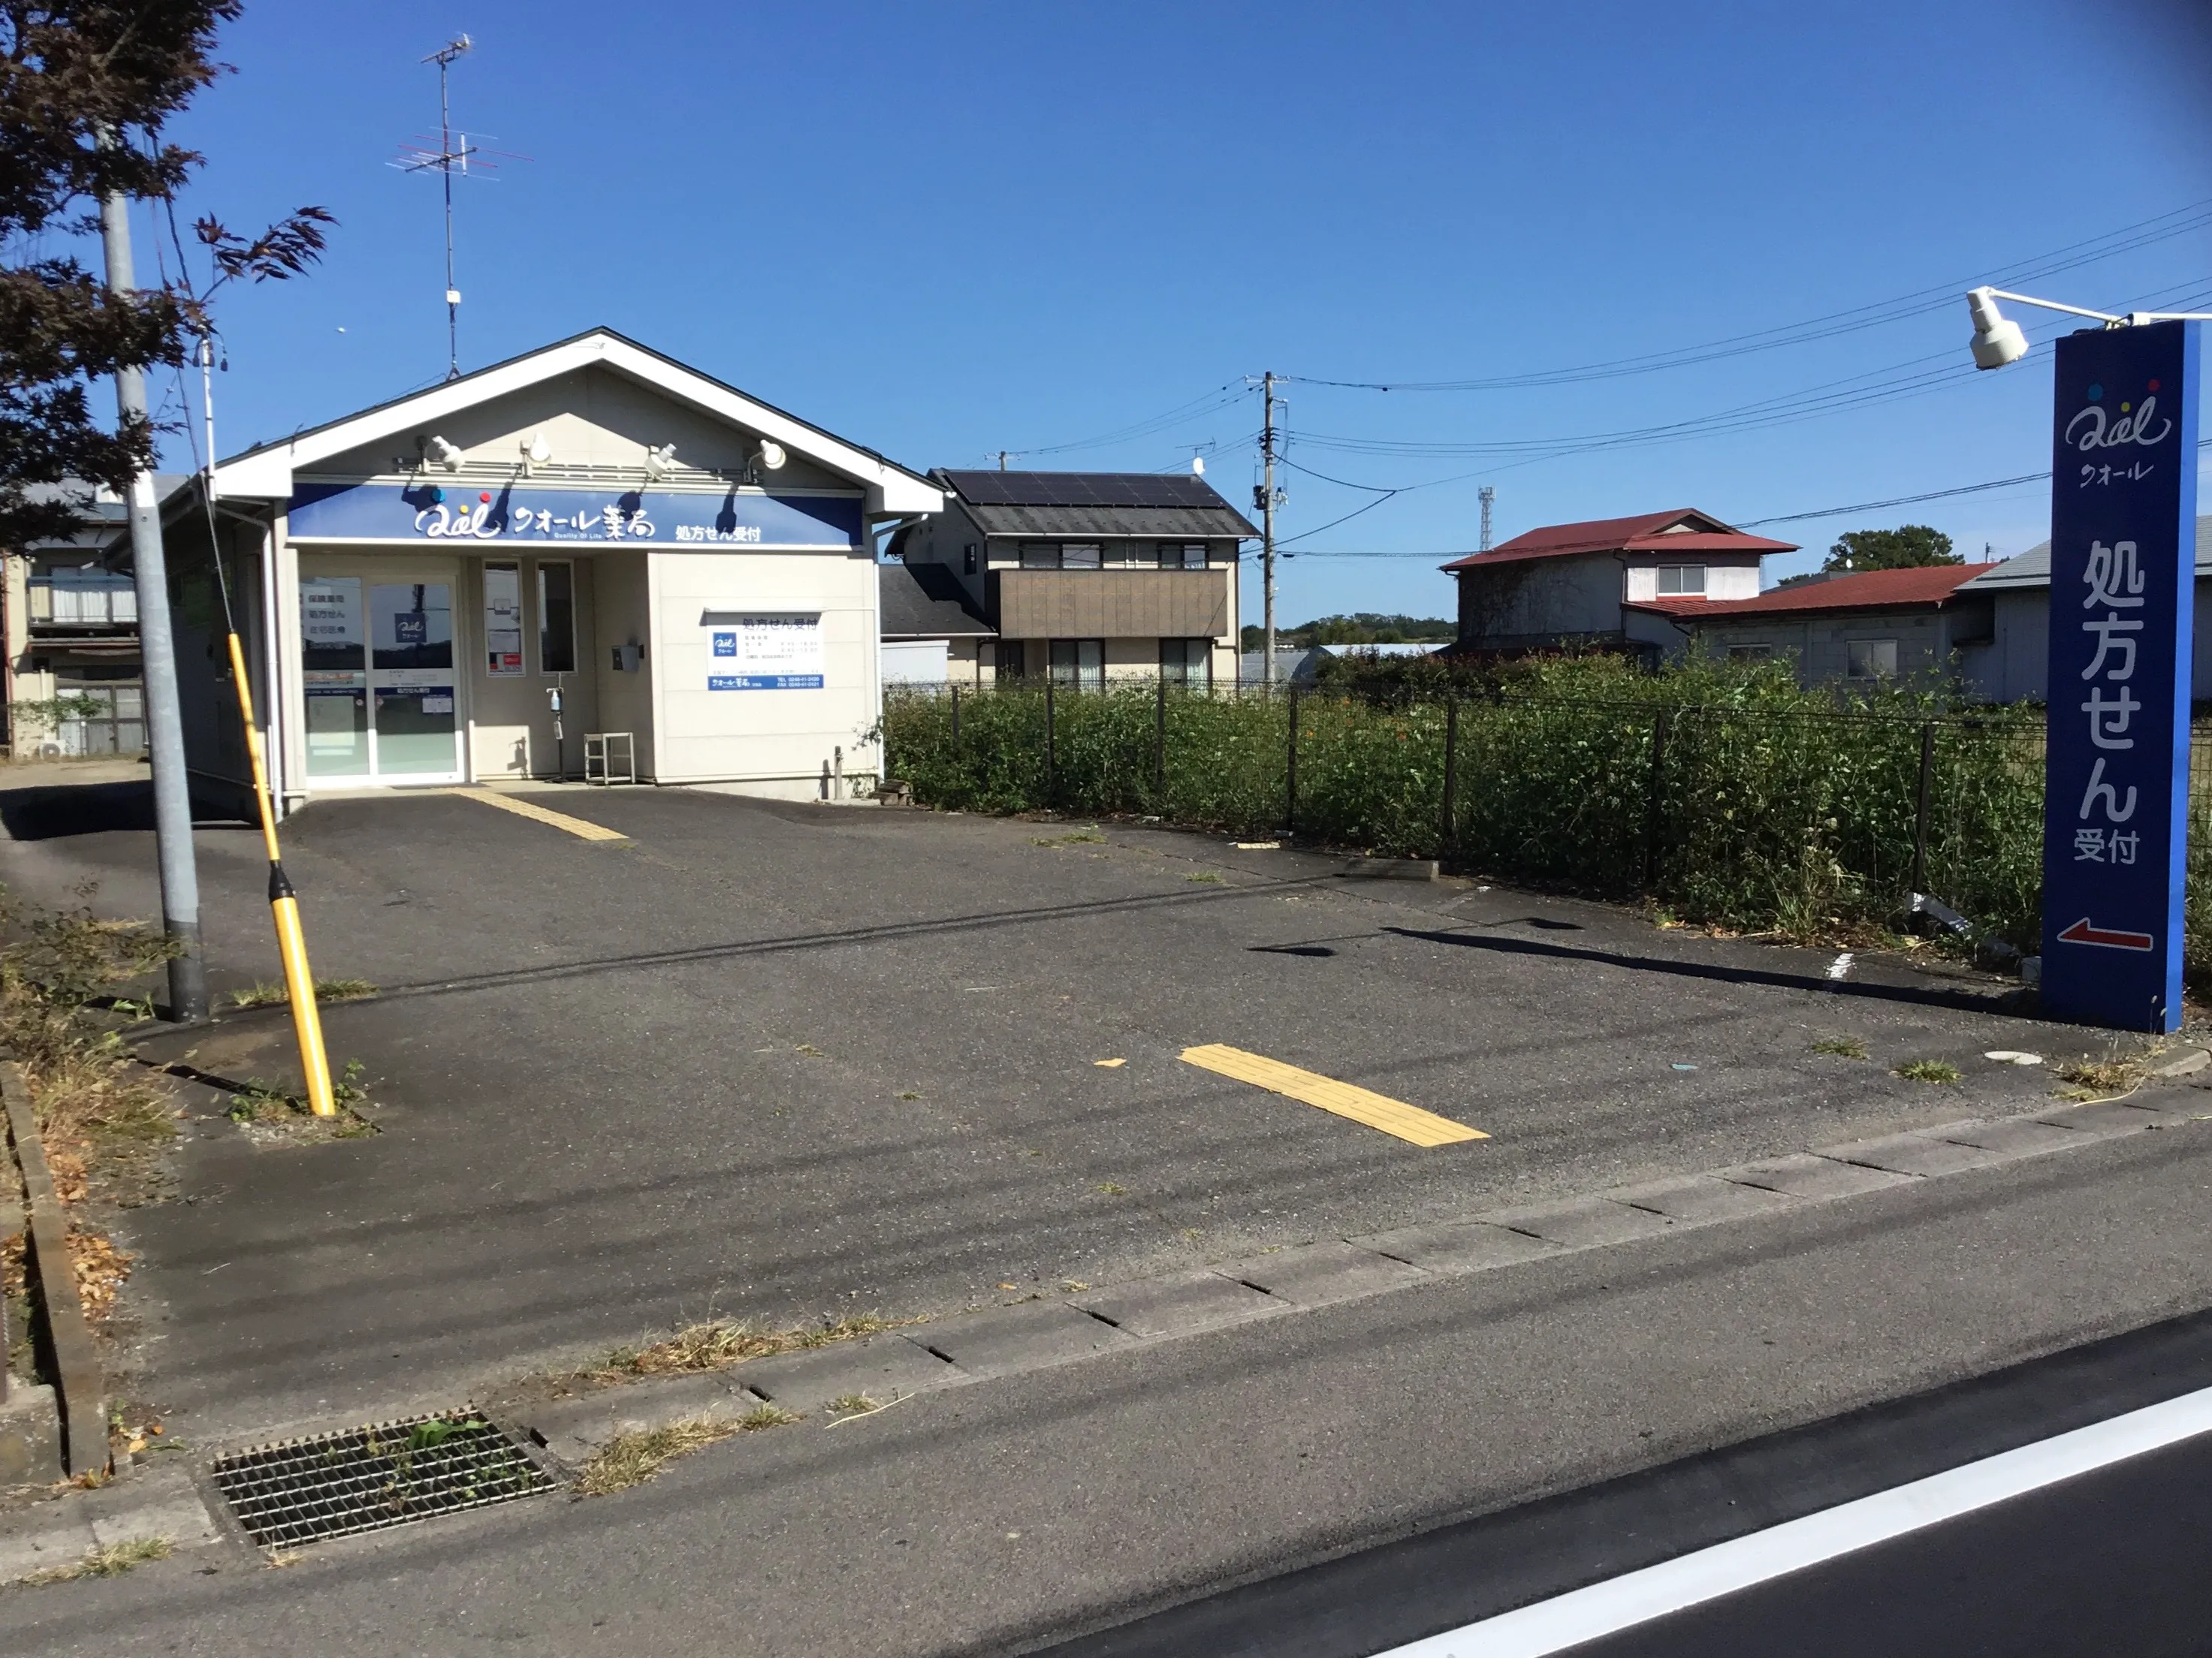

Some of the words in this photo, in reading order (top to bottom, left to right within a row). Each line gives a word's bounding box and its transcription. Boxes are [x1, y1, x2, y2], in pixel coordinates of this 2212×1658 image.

[2080, 460, 2155, 488] クオール
[514, 504, 656, 539] クオール薬局
[675, 525, 761, 541] 処方せん受付
[742, 618, 818, 631] 処方せん受付
[2079, 540, 2144, 822] 処方せん
[2074, 828, 2140, 864] 受付
